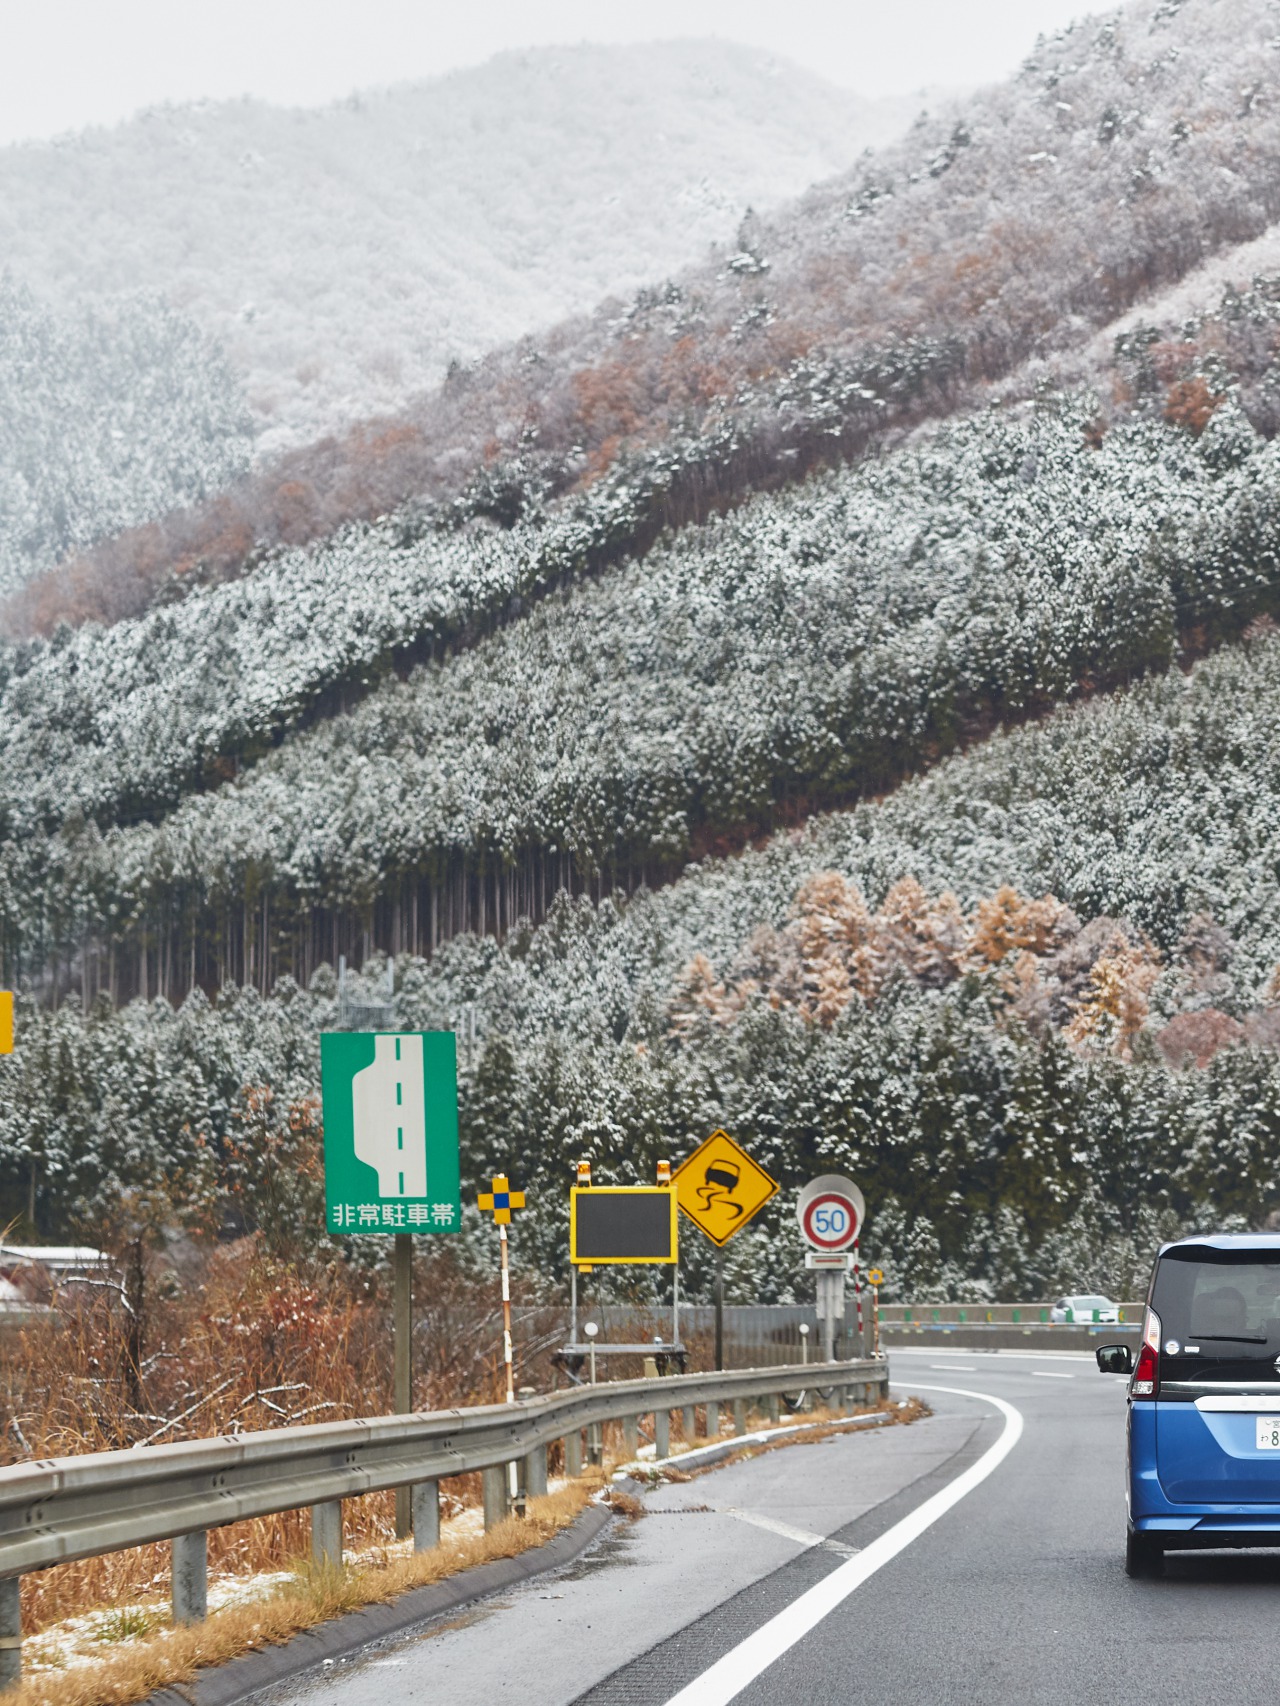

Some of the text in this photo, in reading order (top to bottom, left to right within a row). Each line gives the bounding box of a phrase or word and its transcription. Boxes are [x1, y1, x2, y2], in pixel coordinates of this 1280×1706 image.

[333, 1203, 455, 1227] 非常駐車帯
[816, 1209, 845, 1233] 50
